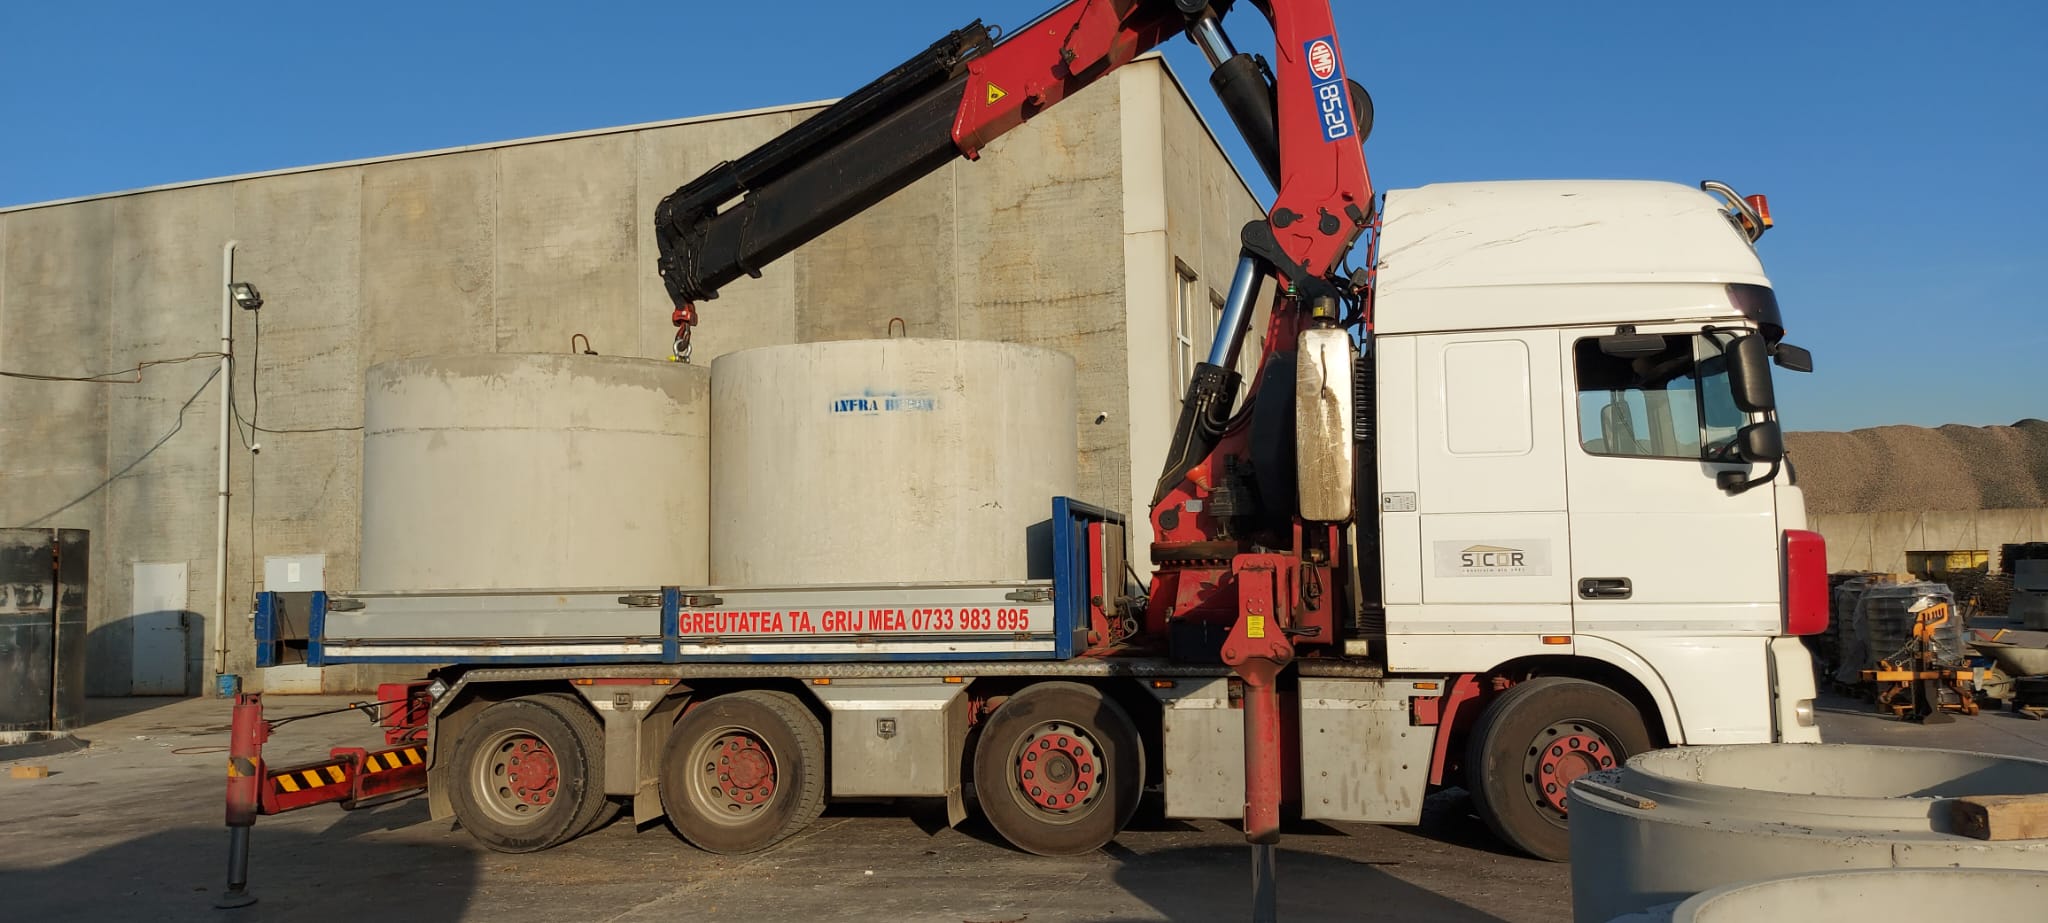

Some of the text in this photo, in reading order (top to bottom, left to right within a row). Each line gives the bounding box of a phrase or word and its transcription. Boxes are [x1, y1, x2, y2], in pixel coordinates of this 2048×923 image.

[1311, 45, 1331, 73] HMF
[1320, 84, 1347, 138] 8520
[834, 400, 878, 412] INFRA
[1461, 552, 1524, 567] SICOR
[679, 609, 1029, 634] GREUTATEA TA, GRIJ MEA 0733 983 895
